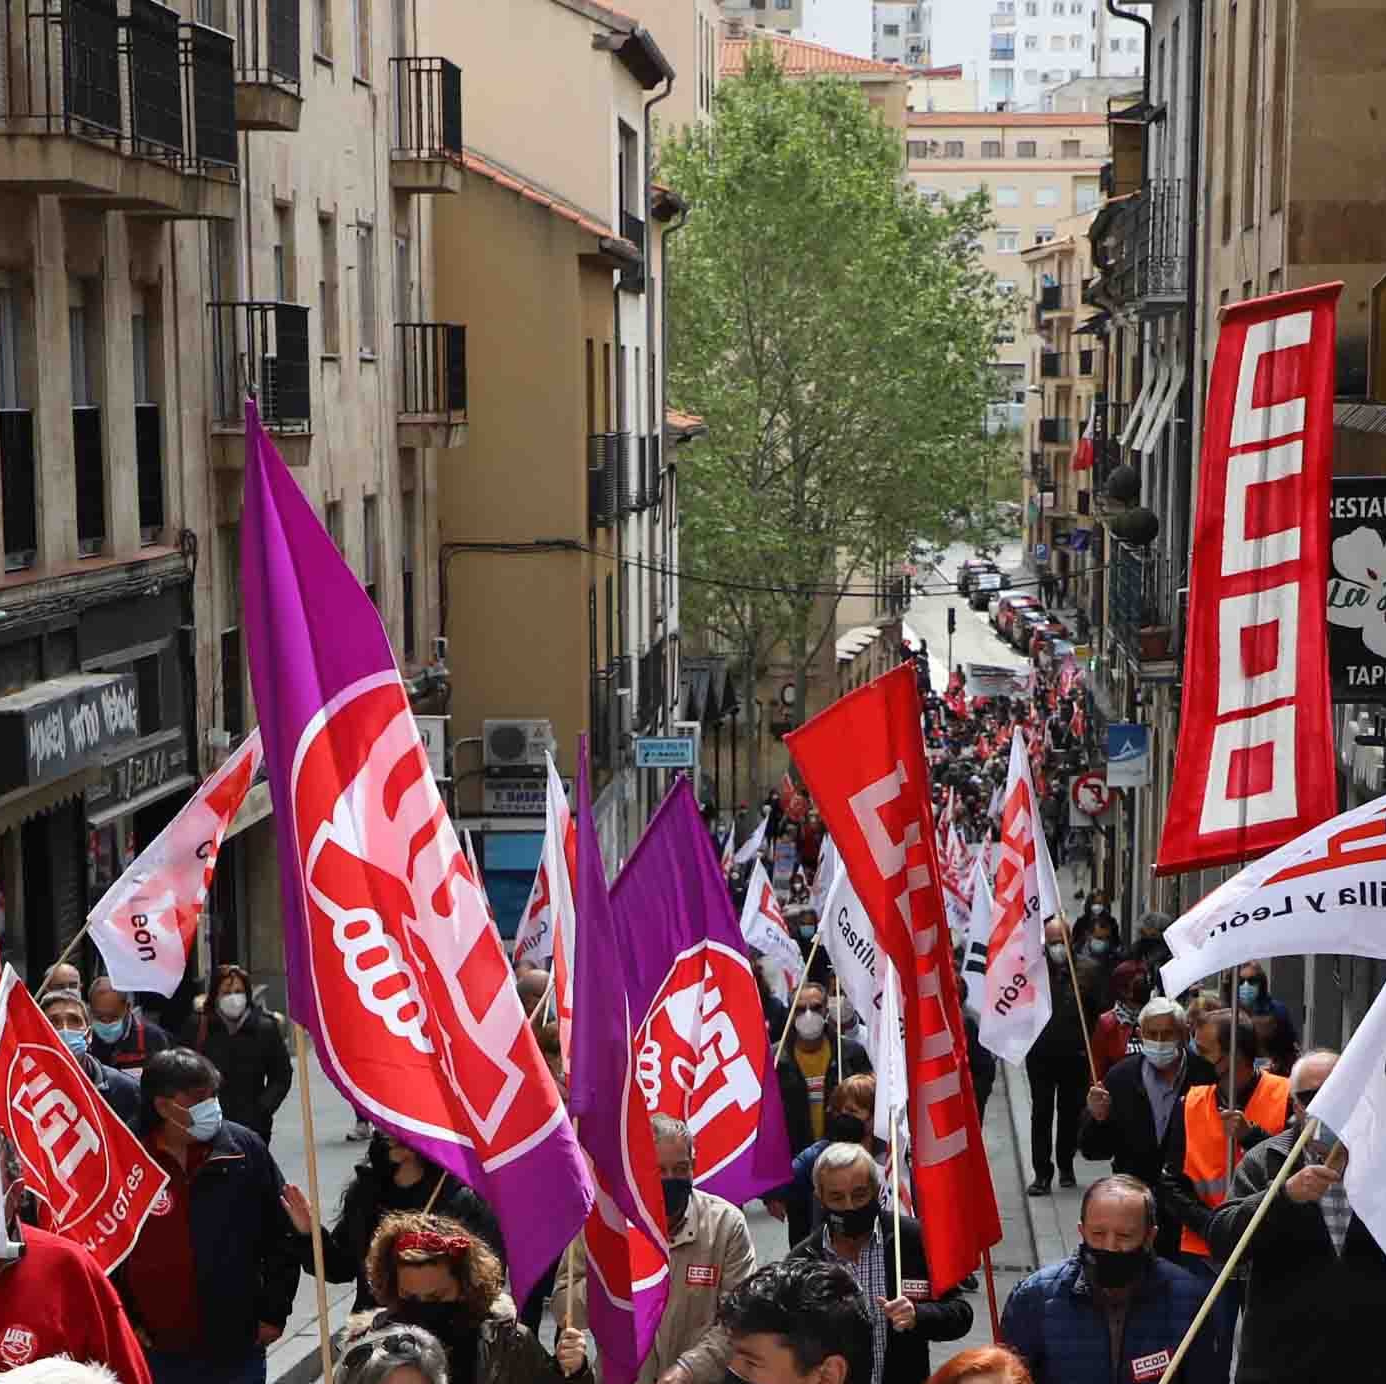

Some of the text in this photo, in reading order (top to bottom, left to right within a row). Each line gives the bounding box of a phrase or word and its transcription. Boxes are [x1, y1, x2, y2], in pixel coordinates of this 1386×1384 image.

[1199, 310, 1313, 835] CCOO
[1328, 580, 1370, 608] La
[130, 912, 158, 963] eón
[1135, 1354, 1166, 1371] CCOO
